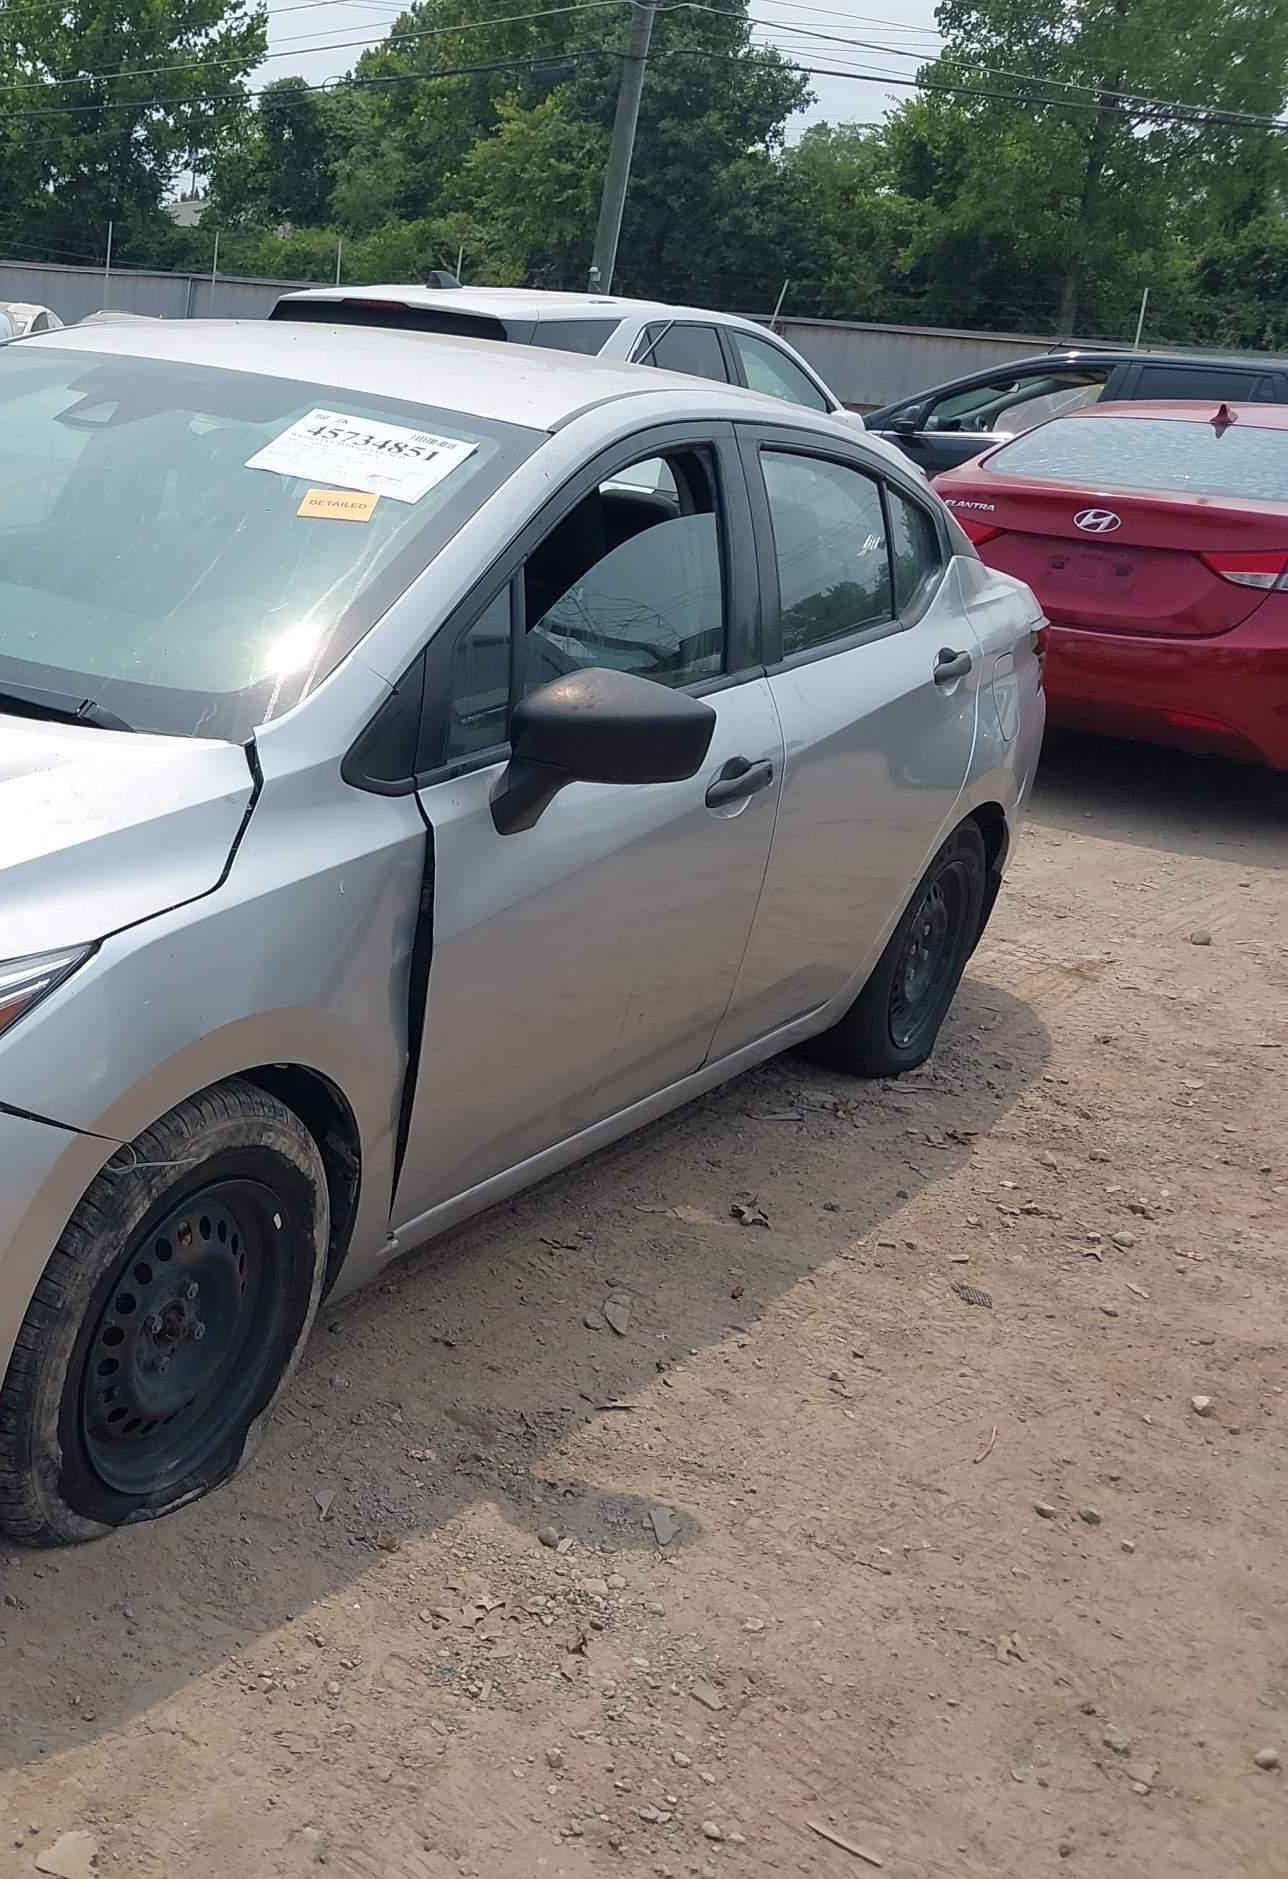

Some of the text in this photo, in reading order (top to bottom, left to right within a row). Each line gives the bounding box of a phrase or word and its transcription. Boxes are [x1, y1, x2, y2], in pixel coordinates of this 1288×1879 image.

[307, 425, 440, 461] 45734851
[309, 499, 368, 510] DETAILED
[944, 499, 995, 512] ELANTRA
